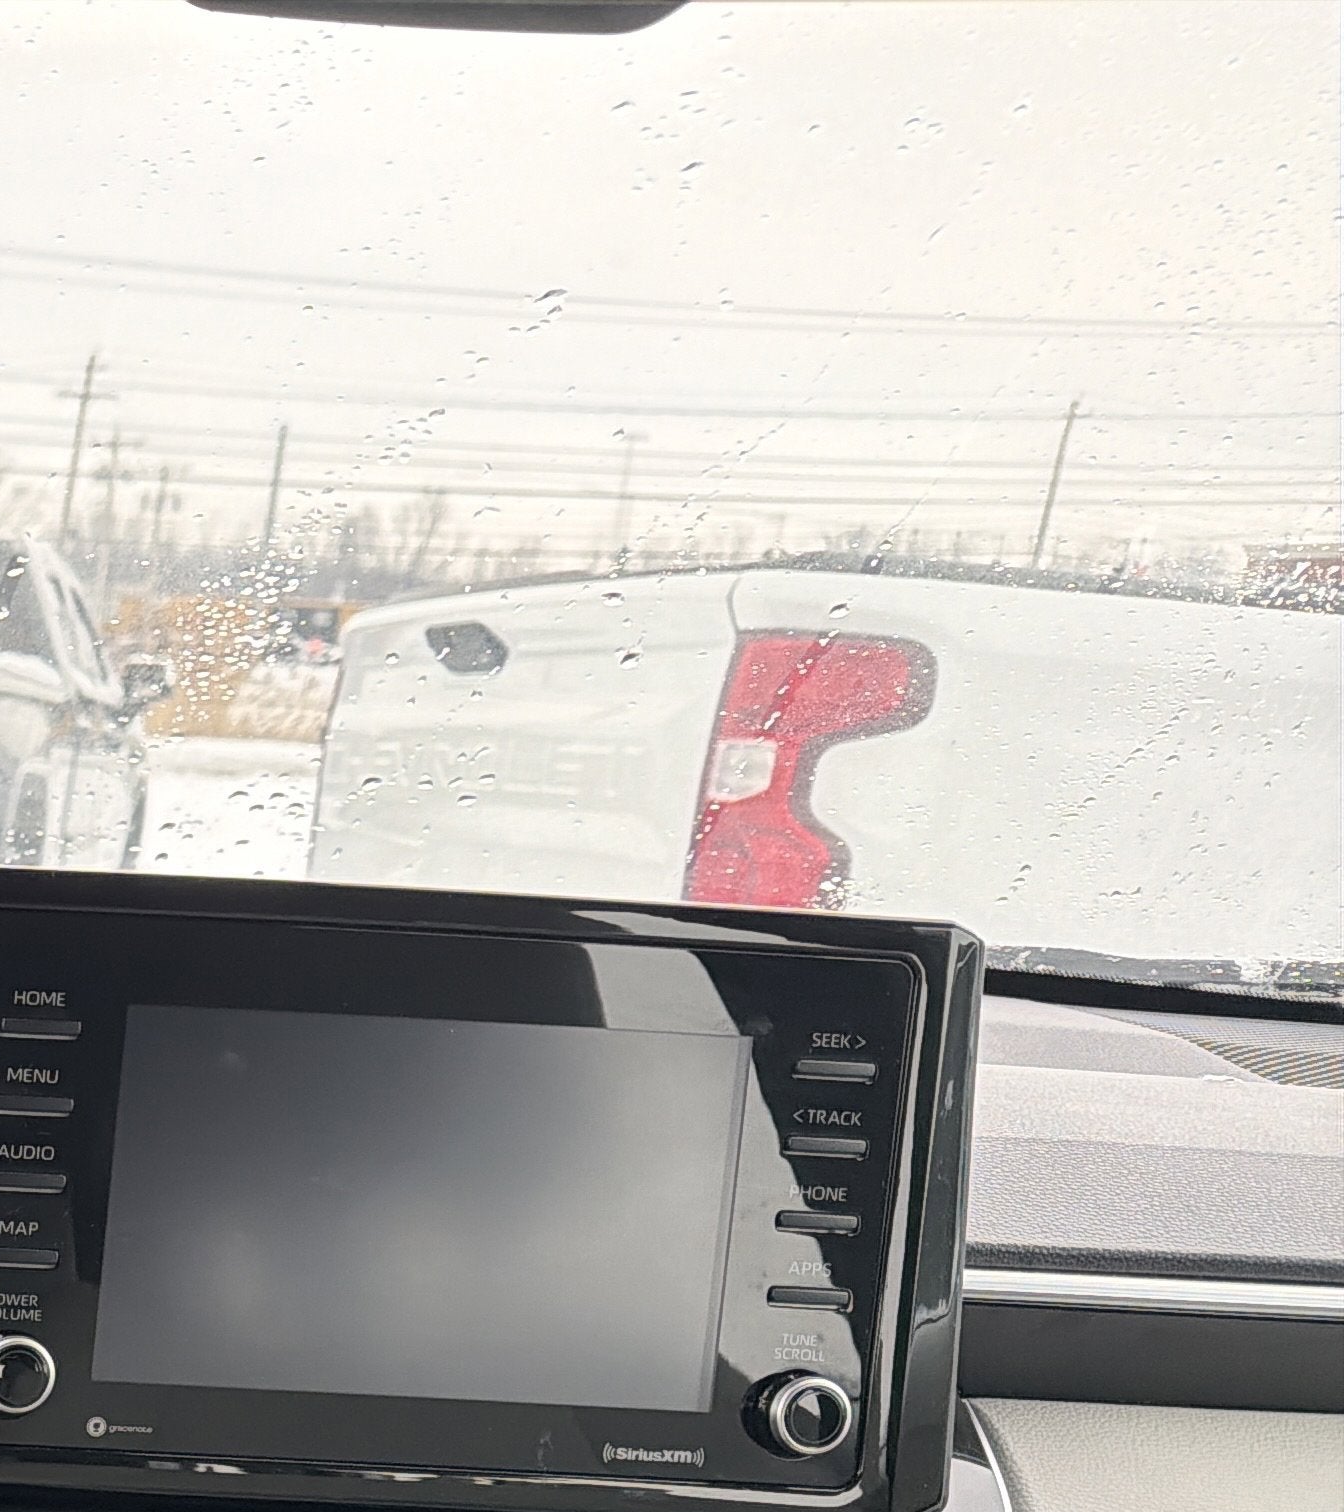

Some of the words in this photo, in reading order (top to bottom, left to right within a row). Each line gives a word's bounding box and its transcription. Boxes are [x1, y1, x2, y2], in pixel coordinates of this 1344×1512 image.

[13, 990, 66, 1007] HOME
[811, 1032, 851, 1049] SEEK
[6, 1067, 59, 1084] MENU
[807, 1109, 862, 1126] TRACK
[789, 1184, 848, 1202] PHONE
[788, 1260, 833, 1278] APPS
[782, 1333, 818, 1348] TUNE
[774, 1347, 826, 1362] SCROLL
